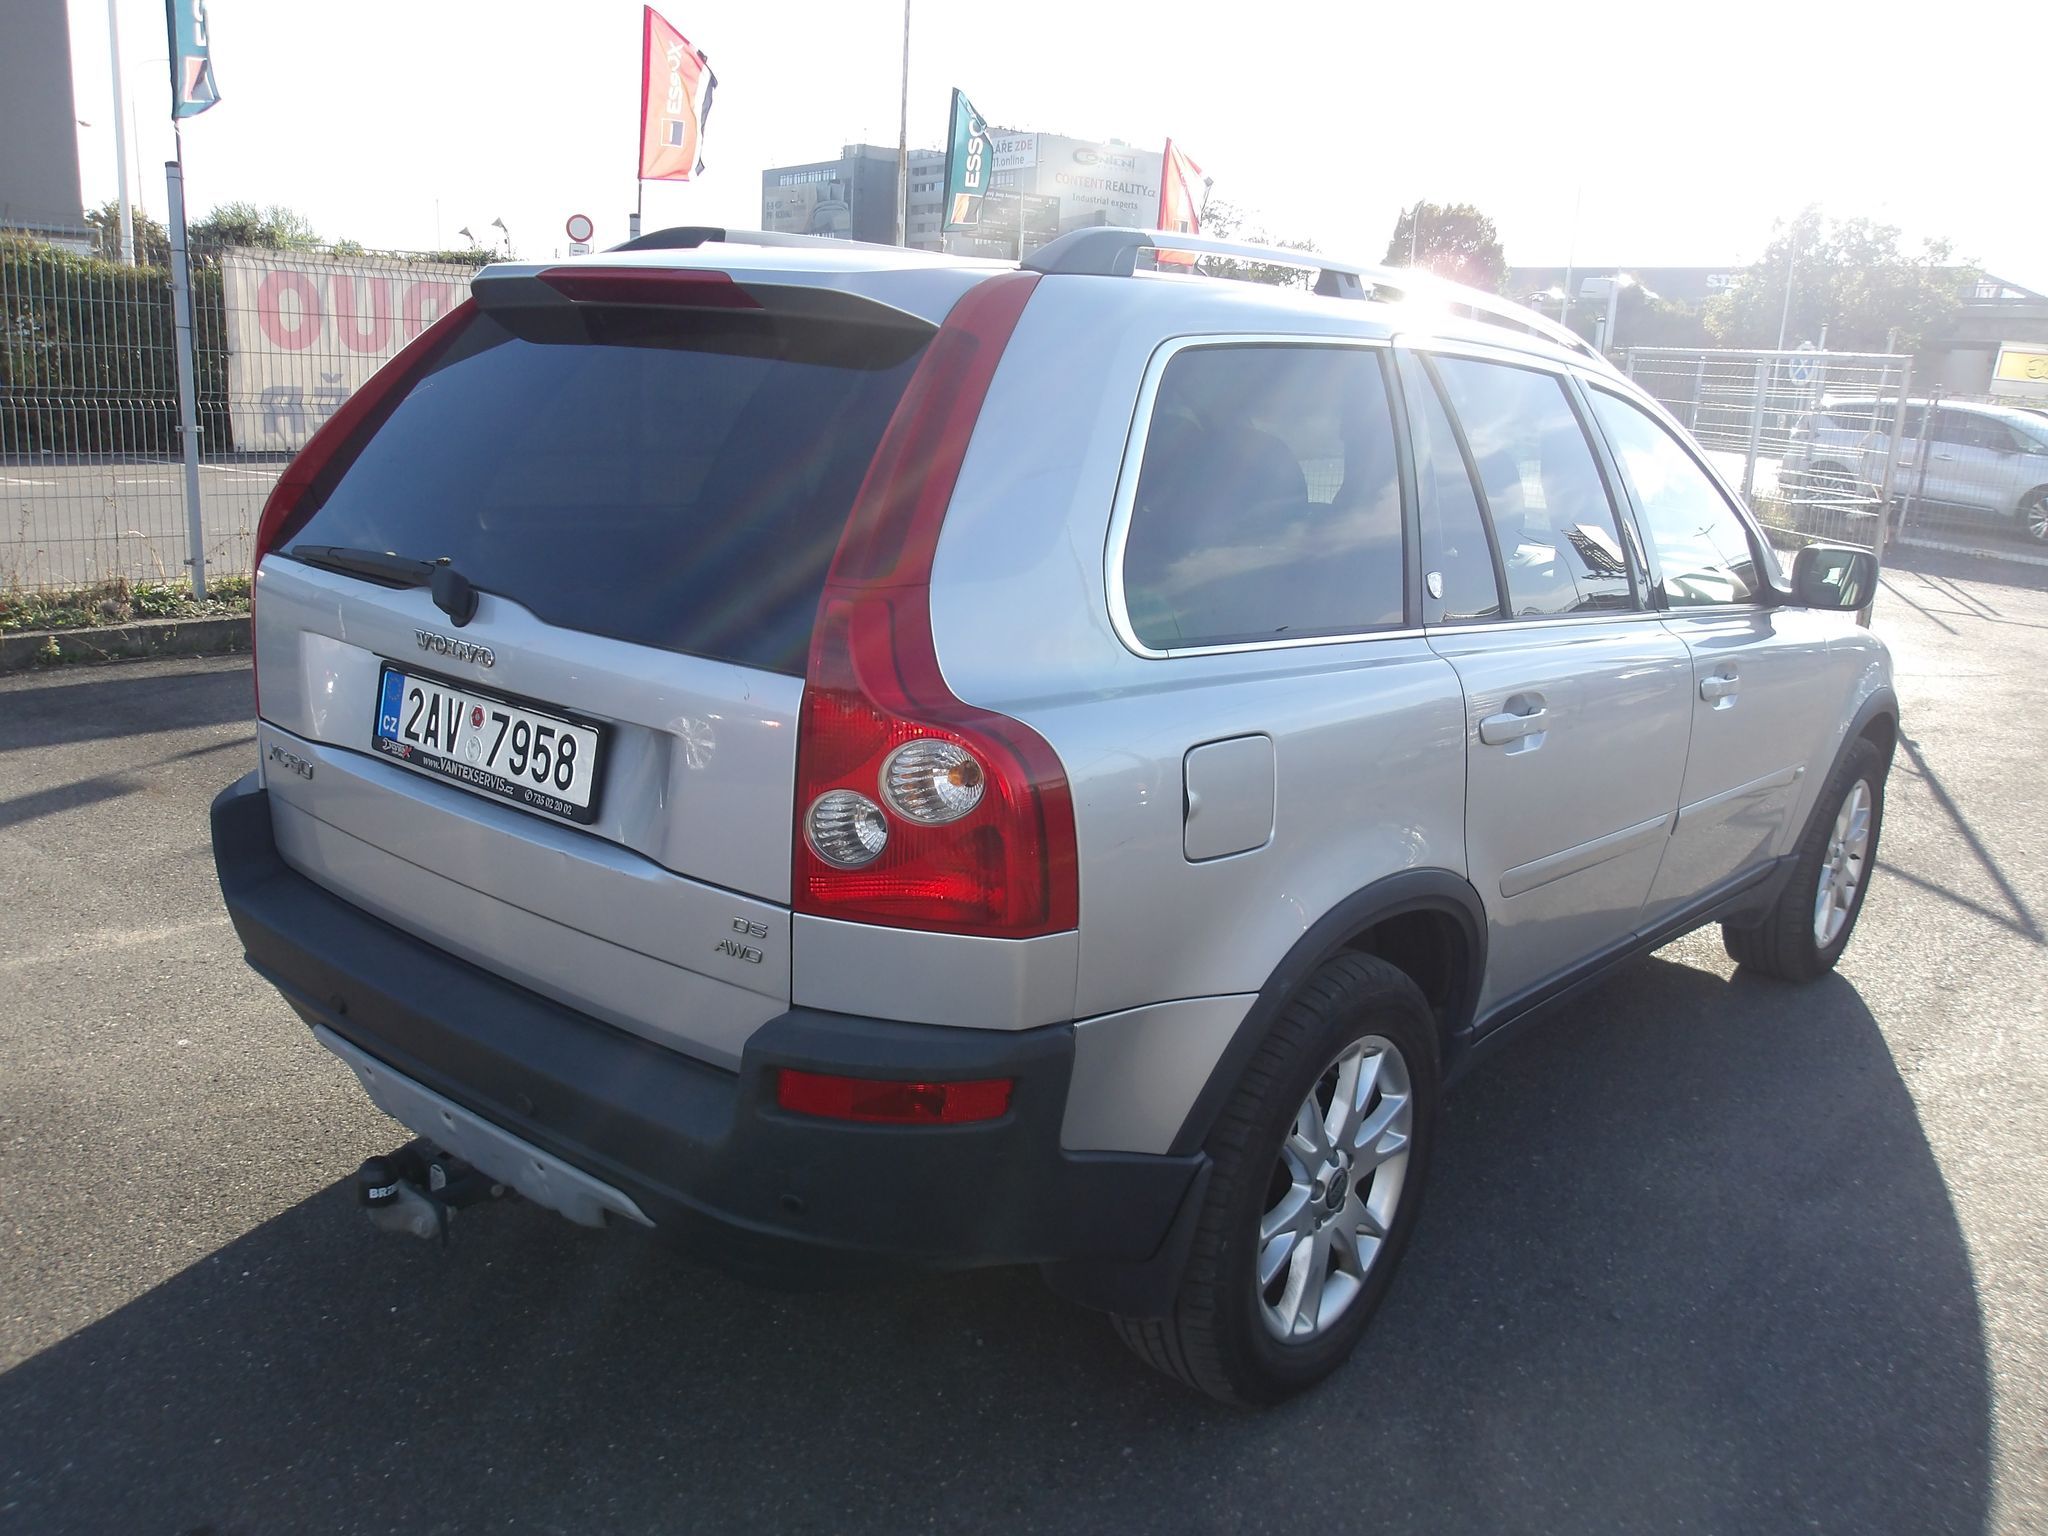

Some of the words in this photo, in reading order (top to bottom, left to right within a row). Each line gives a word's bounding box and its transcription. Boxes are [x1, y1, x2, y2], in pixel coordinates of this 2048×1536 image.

[665, 40, 686, 116] ESSOX
[964, 118, 985, 188] ESSO
[1014, 139, 1033, 152] ZDE
[1072, 193, 1109, 206] Industrial
[1110, 199, 1138, 210] experts
[414, 628, 496, 668] VOLVO
[383, 715, 398, 733] CZ
[404, 687, 466, 755] 2AV
[486, 711, 578, 791] 7958
[422, 756, 514, 795] www.VANTEXSERVIS.cz
[732, 916, 768, 939] D5
[713, 939, 763, 964] AWD
